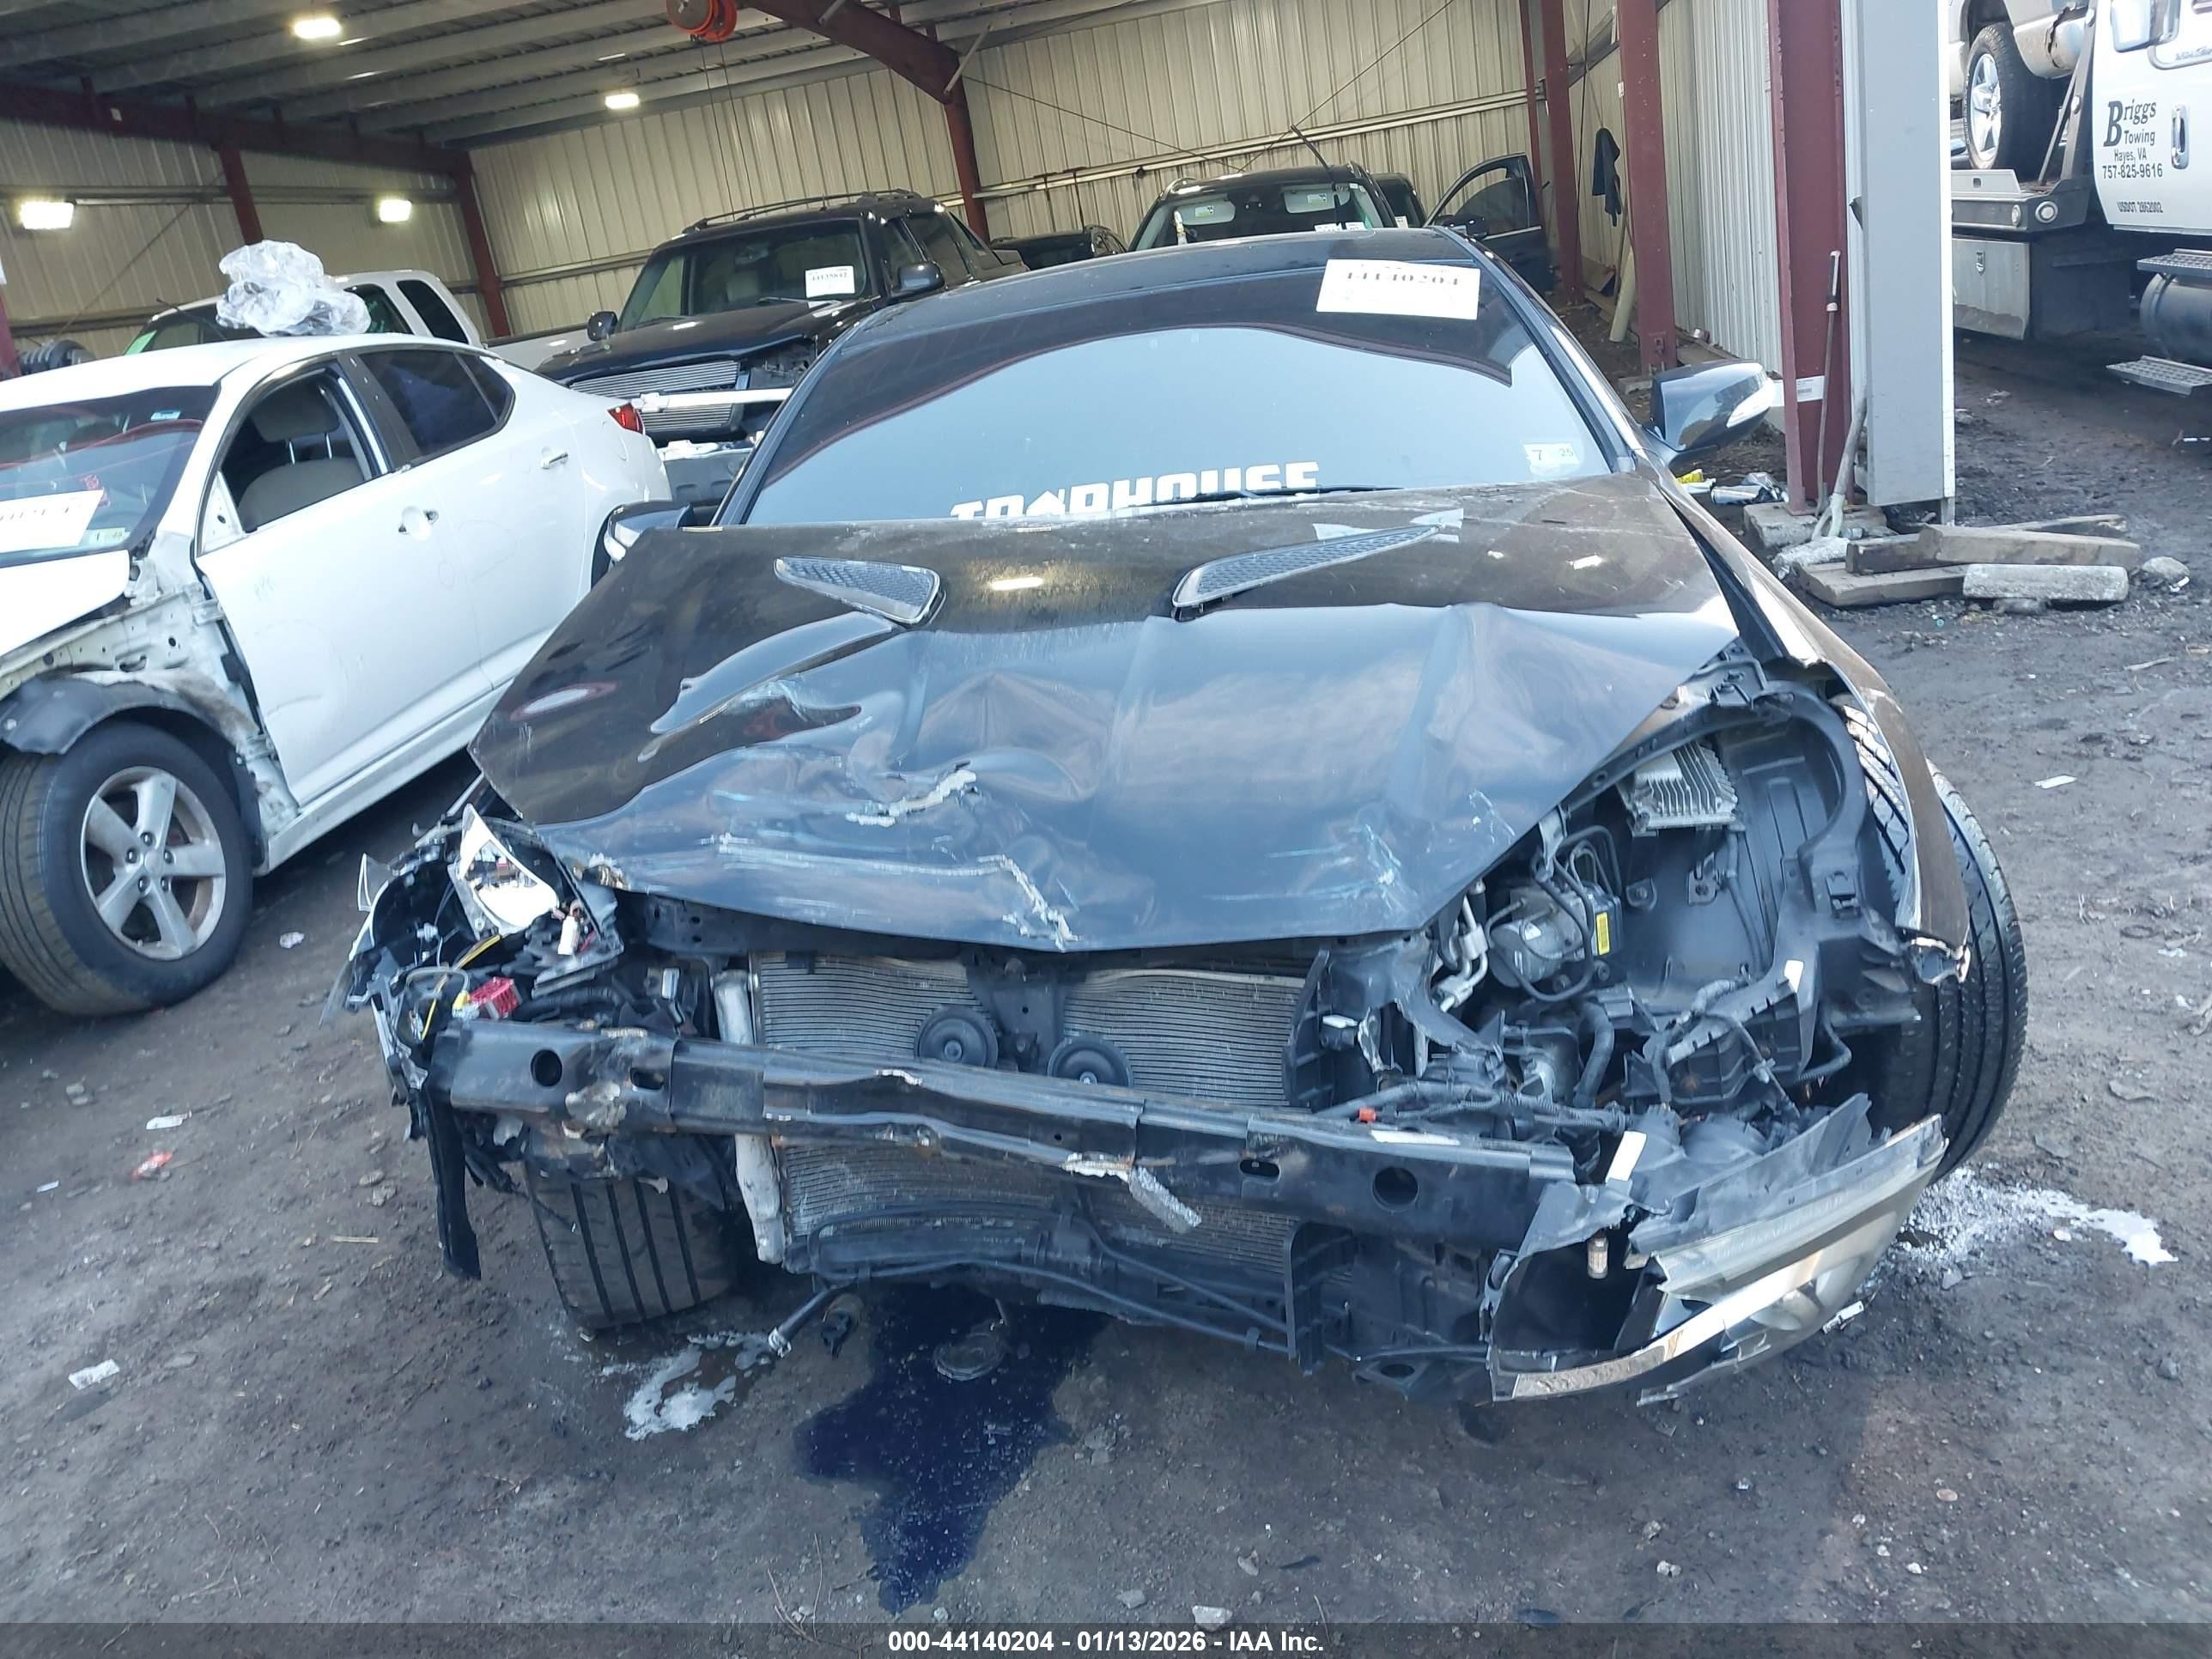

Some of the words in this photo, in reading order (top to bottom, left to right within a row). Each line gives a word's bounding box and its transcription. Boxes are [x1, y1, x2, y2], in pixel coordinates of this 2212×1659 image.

[2104, 99, 2156, 147] Briggs
[2124, 129, 2155, 146] Towing
[2114, 149, 2136, 164] Hayes,
[2138, 148, 2147, 161] VA
[2102, 163, 2163, 179] 757-825-9616
[2117, 201, 2137, 213] USDOT
[1531, 449, 1543, 461] 7
